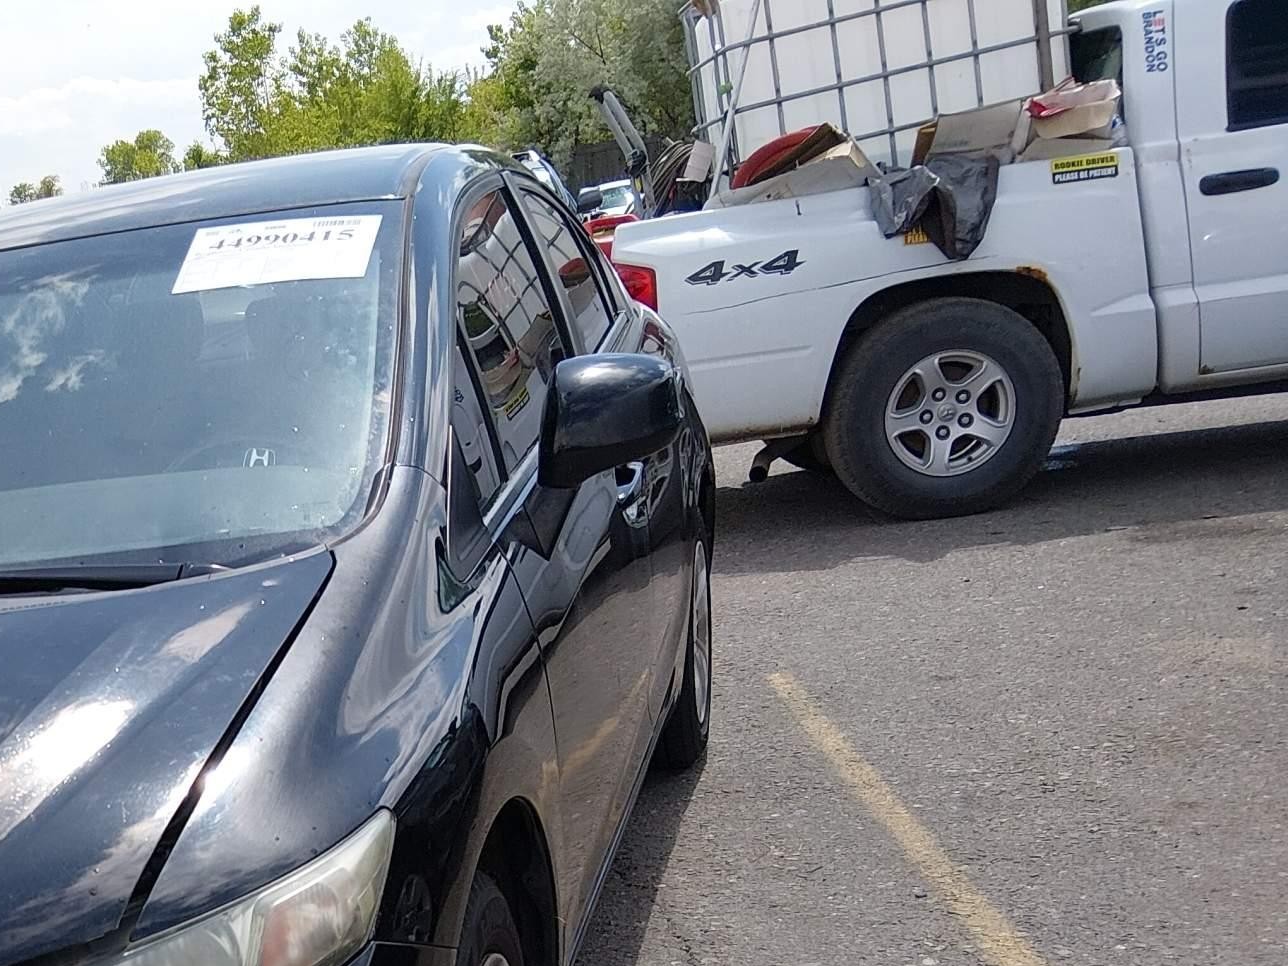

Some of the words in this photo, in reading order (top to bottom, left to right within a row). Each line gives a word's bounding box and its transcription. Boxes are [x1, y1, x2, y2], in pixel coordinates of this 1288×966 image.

[1142, 11, 1157, 73] BRANDON
[1155, 50, 1169, 73] GO
[1054, 159, 1084, 170] ROOKIE
[1085, 155, 1115, 166] DRIVER
[1054, 171, 1079, 183] PLEASE
[1079, 169, 1089, 178] BE
[684, 249, 807, 286] 4x4
